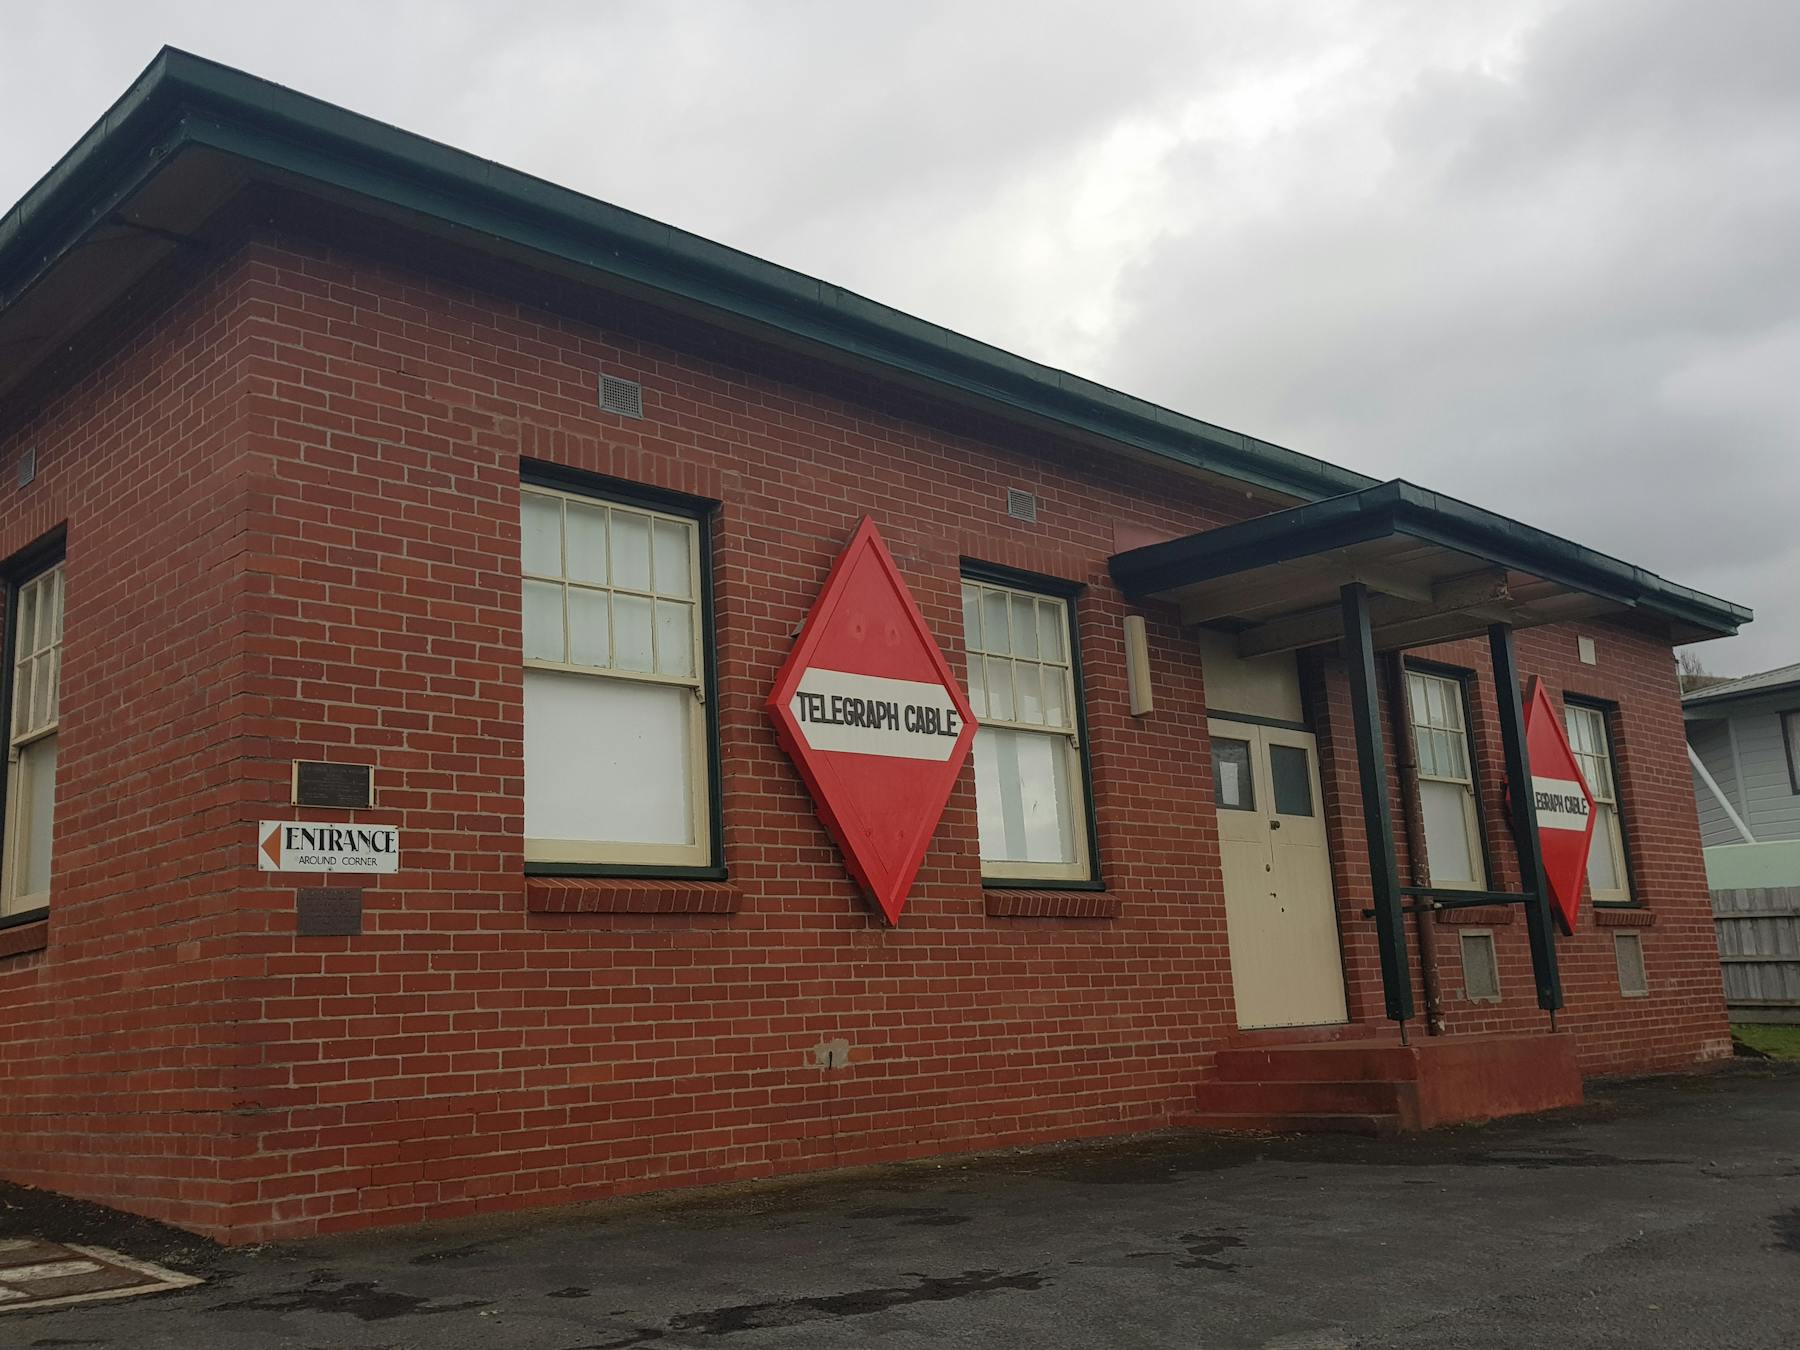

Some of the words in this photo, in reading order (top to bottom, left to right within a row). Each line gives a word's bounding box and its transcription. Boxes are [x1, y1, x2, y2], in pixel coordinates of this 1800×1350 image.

[797, 691, 899, 730] TELEGRAPH
[904, 704, 958, 737] CABLE
[1535, 791, 1564, 813] EGRAPH
[1565, 795, 1588, 815] CABLE
[285, 827, 396, 853] ENTRANCE
[299, 855, 336, 865] AROUND
[342, 856, 377, 866] CORNER
